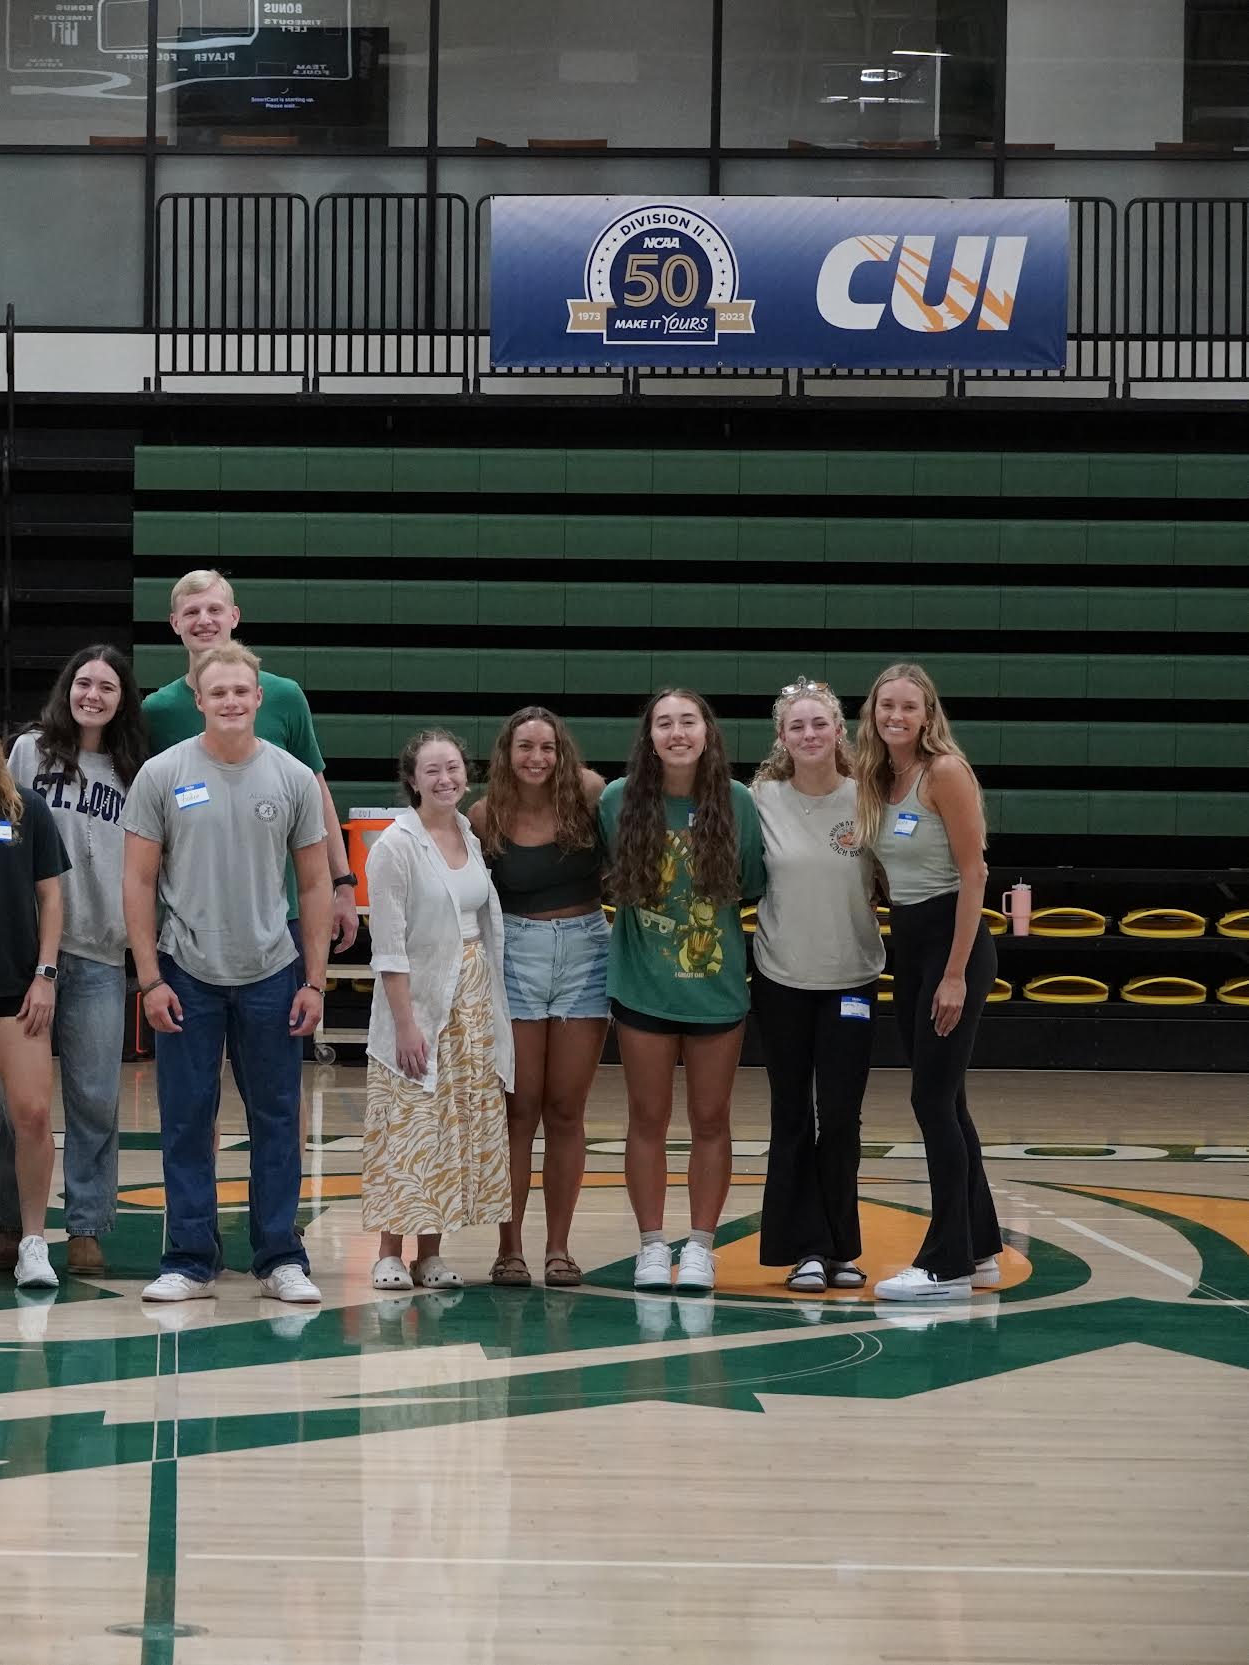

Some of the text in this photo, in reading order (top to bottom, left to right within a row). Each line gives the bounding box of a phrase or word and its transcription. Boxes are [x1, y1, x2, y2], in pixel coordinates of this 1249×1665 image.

[619, 213, 705, 238] DIVISION II
[642, 237, 681, 249] NCAA
[623, 253, 699, 308] 50
[816, 234, 1028, 333] CUI
[577, 311, 601, 321] 1973
[614, 312, 709, 335] MAKE IT YOURS
[719, 312, 745, 321] 2023
